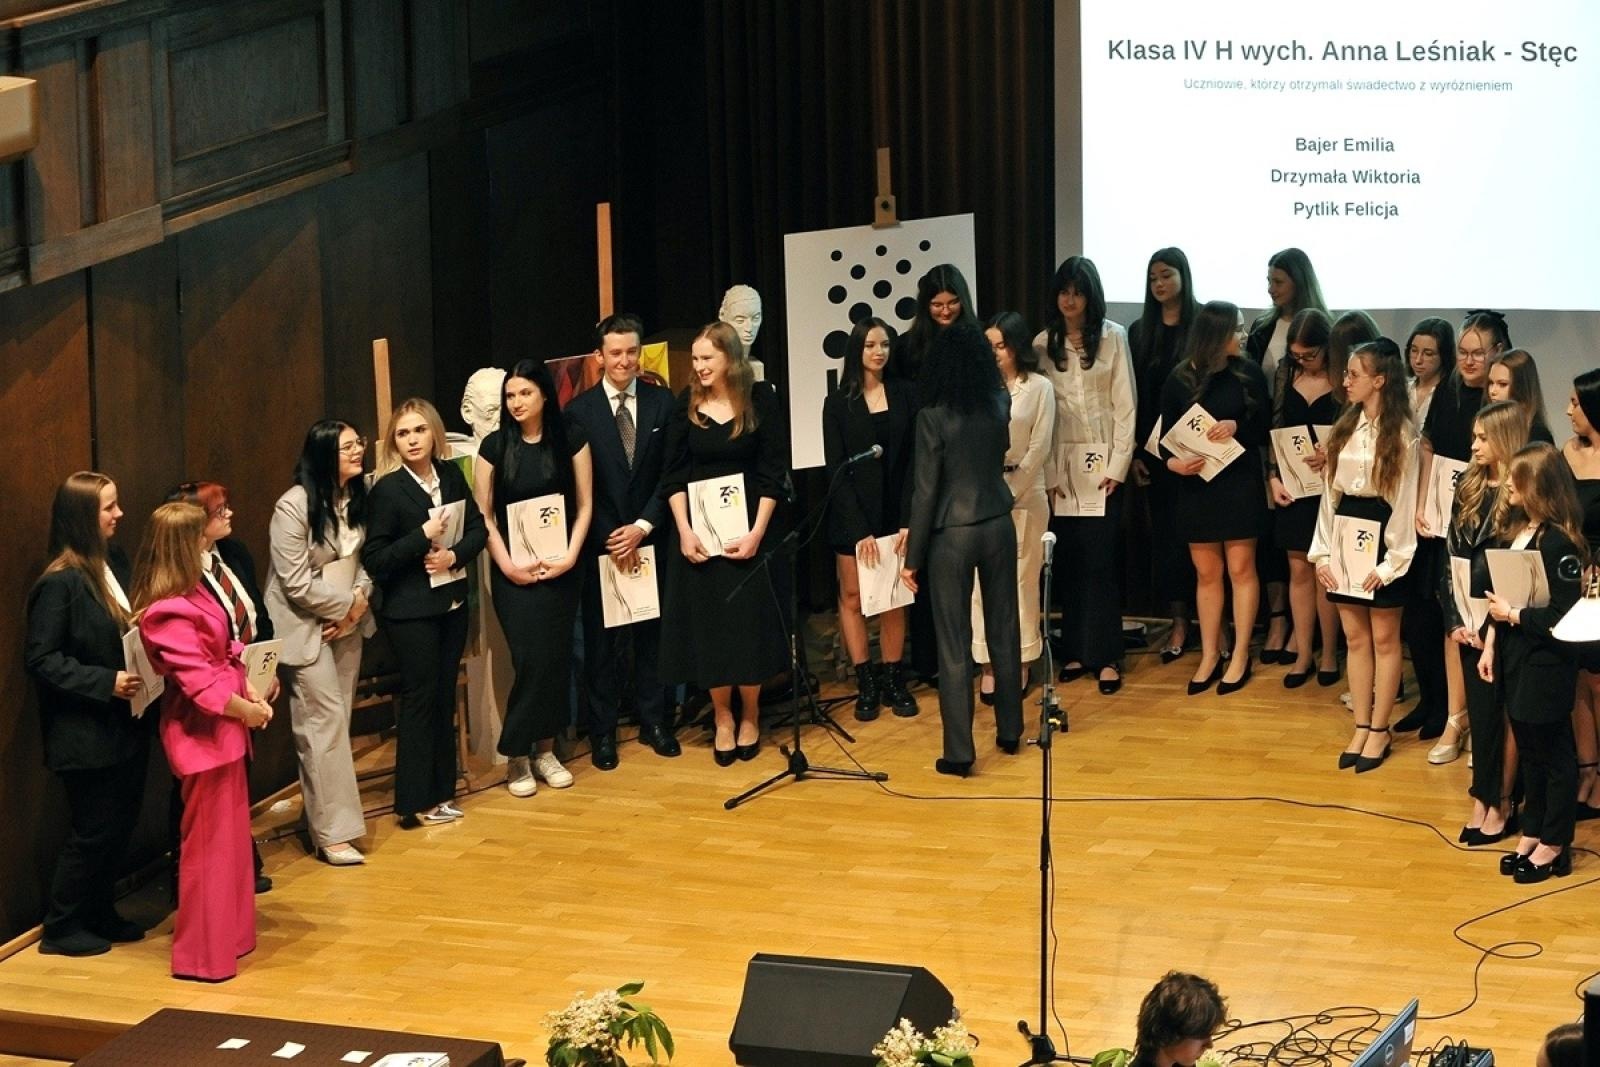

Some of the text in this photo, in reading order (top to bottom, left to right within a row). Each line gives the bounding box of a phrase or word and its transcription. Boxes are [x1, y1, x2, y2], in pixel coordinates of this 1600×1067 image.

[1108, 39, 1177, 61] Klasa
[1184, 40, 1208, 61] IV
[1215, 40, 1233, 61] H
[1240, 39, 1313, 67] wych.
[1321, 40, 1389, 62] Anna
[1396, 39, 1496, 62] Leśniak
[1520, 40, 1578, 68] Stęc
[1183, 78, 1513, 94] Uczniowie, którzy otrzymali świadectwo z wyróżnieniem
[1295, 136, 1395, 156] Bajer Emilia
[1271, 168, 1421, 188] Drzymała Wiktoria
[1293, 200, 1399, 220] Pytlik Felicja
